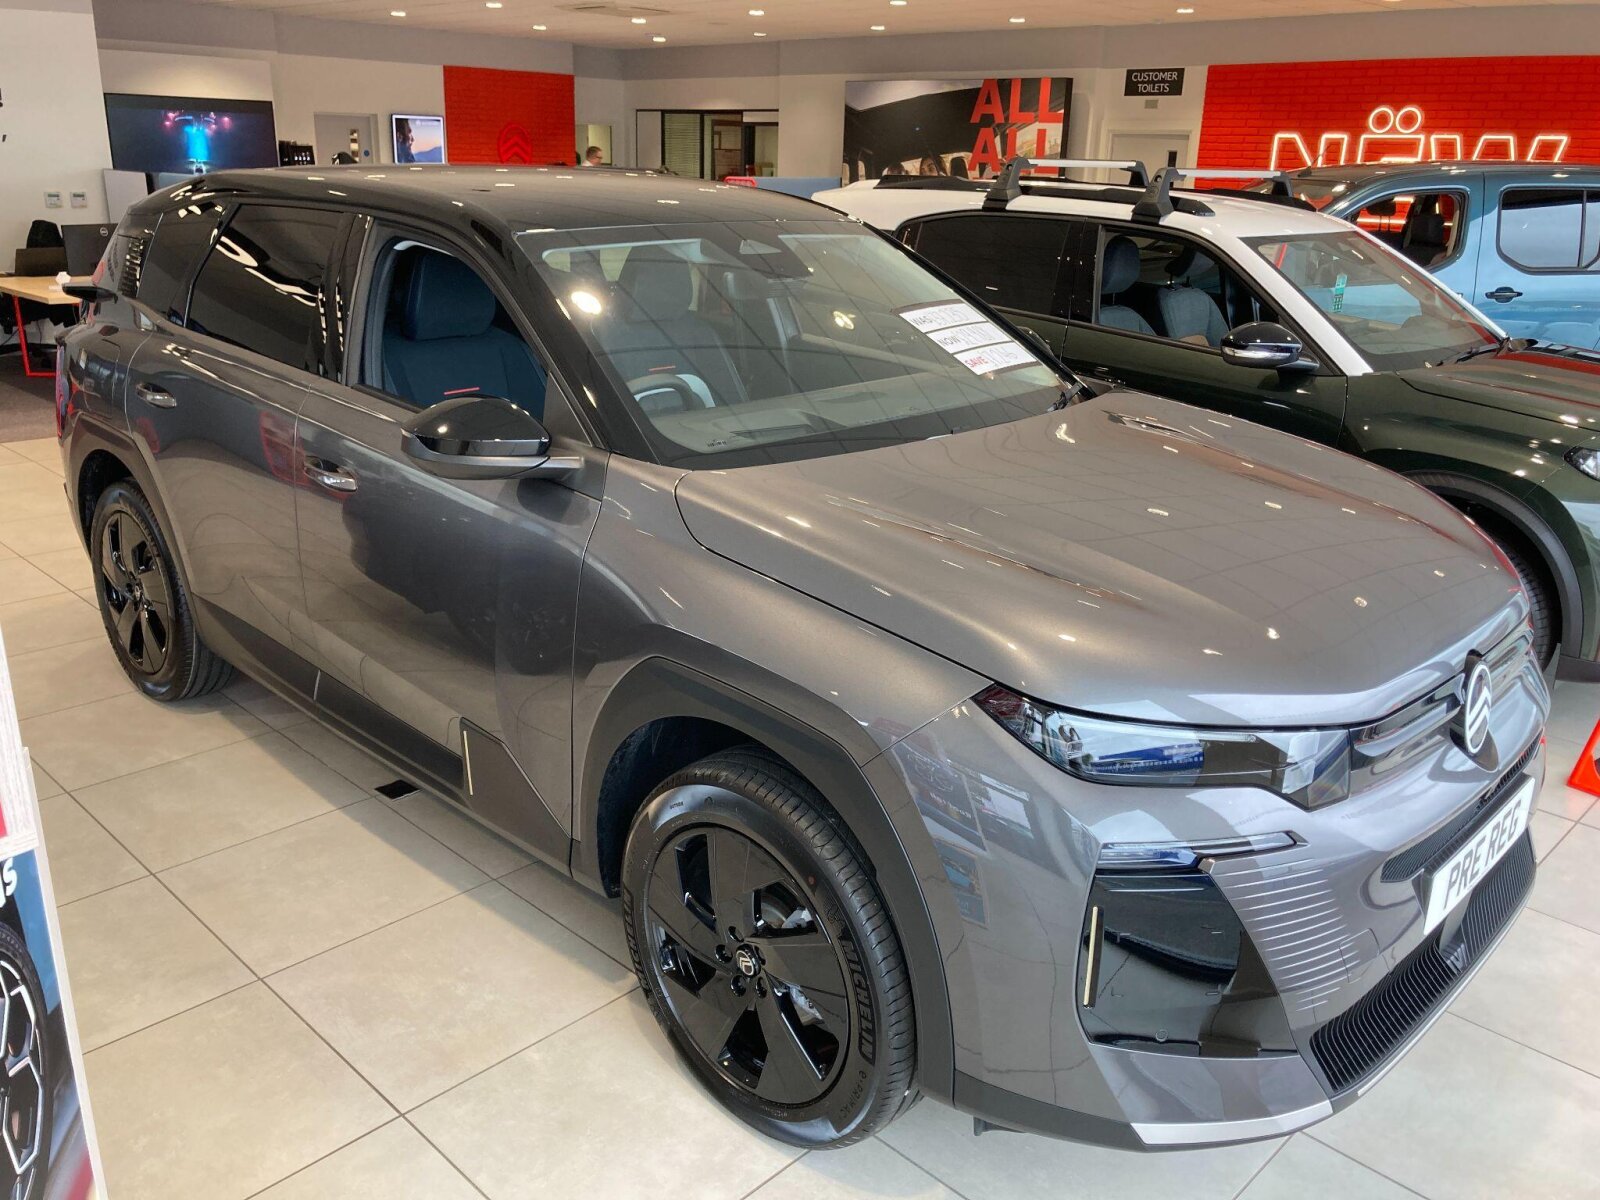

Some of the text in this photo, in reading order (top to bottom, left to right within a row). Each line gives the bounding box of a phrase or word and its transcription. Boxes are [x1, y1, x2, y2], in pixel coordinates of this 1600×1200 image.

[1131, 71, 1178, 82] CUSTOMER
[1137, 83, 1170, 93] TOILETS
[970, 76, 1064, 124] ALL
[964, 357, 989, 368] SAVE
[1443, 799, 1522, 911] PRE REG
[840, 939, 874, 1061] MICHELIN
